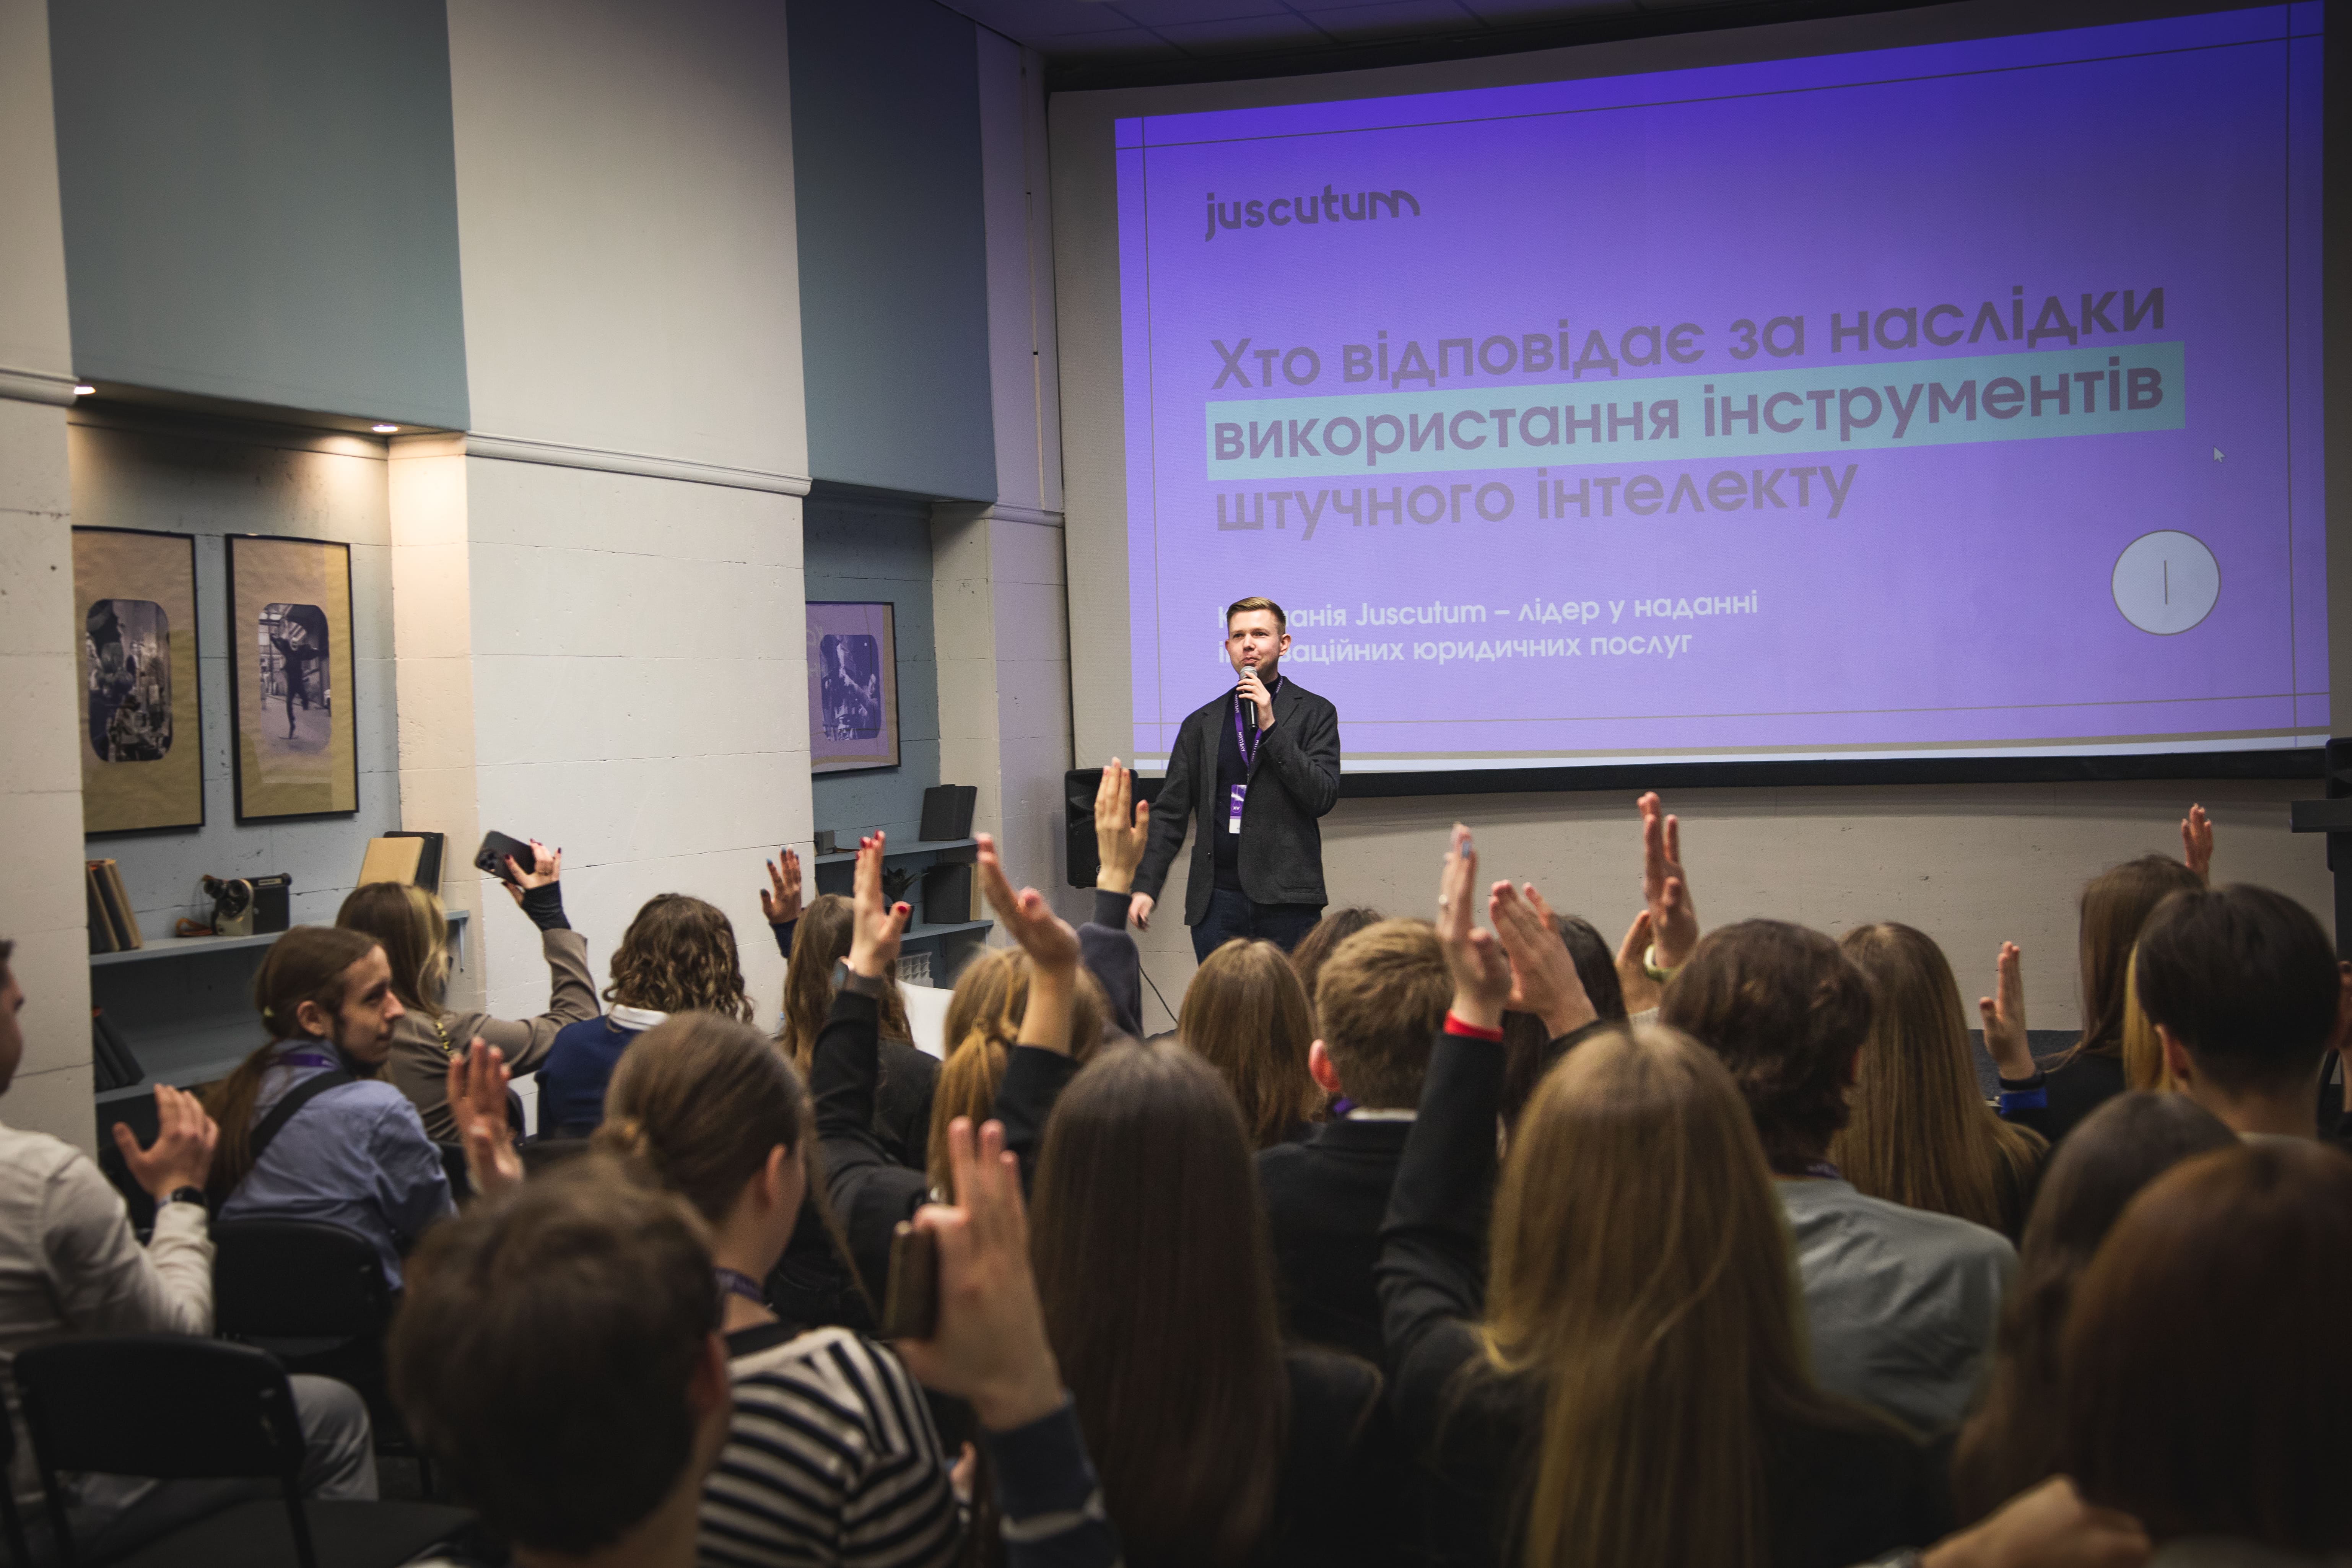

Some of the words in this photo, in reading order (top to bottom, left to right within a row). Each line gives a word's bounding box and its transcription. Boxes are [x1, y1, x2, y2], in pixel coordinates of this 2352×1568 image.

[1205, 184, 1420, 242] juscutum
[1211, 338, 1321, 389] Хто
[1342, 319, 1706, 389] відповідає
[1728, 316, 1805, 361] за
[1831, 285, 2165, 353] наслідки
[1214, 399, 1680, 466] використання
[1703, 356, 2164, 442] інструментів
[1216, 481, 1515, 541] штучного
[1537, 464, 1859, 519] інтелекту
[1218, 603, 1347, 629] Канія
[1355, 600, 1487, 626] Juscutum
[1518, 597, 1600, 625] лідер
[1608, 600, 1625, 624] у
[1634, 589, 1758, 620] наданні
[1218, 638, 1405, 665] іаційних
[1413, 638, 1582, 665] юридичних
[1590, 634, 1693, 659] послуг
